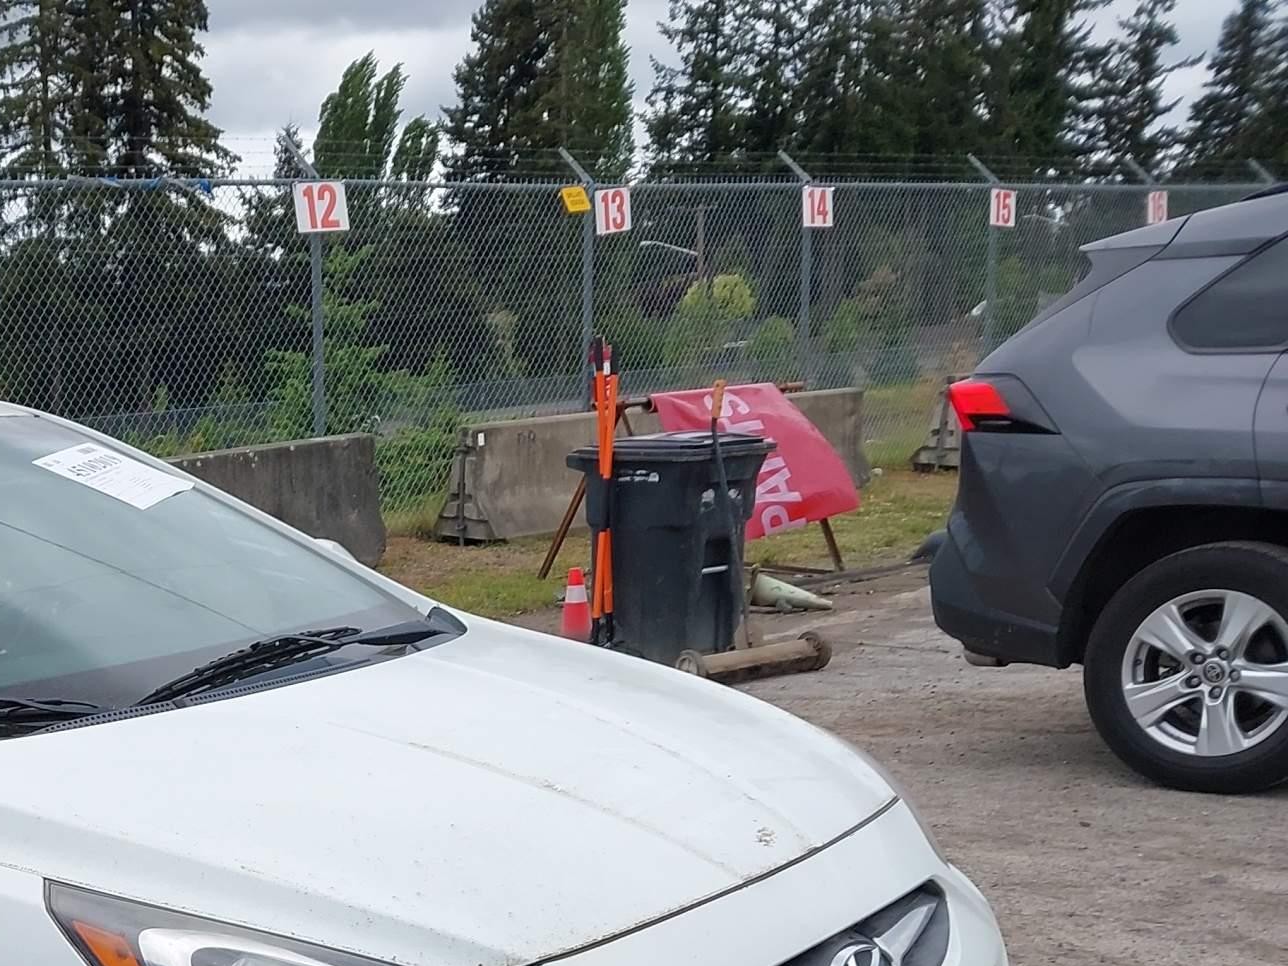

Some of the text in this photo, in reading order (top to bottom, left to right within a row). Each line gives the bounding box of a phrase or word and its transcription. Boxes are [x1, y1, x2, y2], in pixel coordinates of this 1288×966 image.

[302, 183, 340, 229] 12
[601, 190, 625, 231] 13
[808, 189, 829, 224] 14
[995, 190, 1011, 224] 15
[1151, 191, 1165, 223] 16
